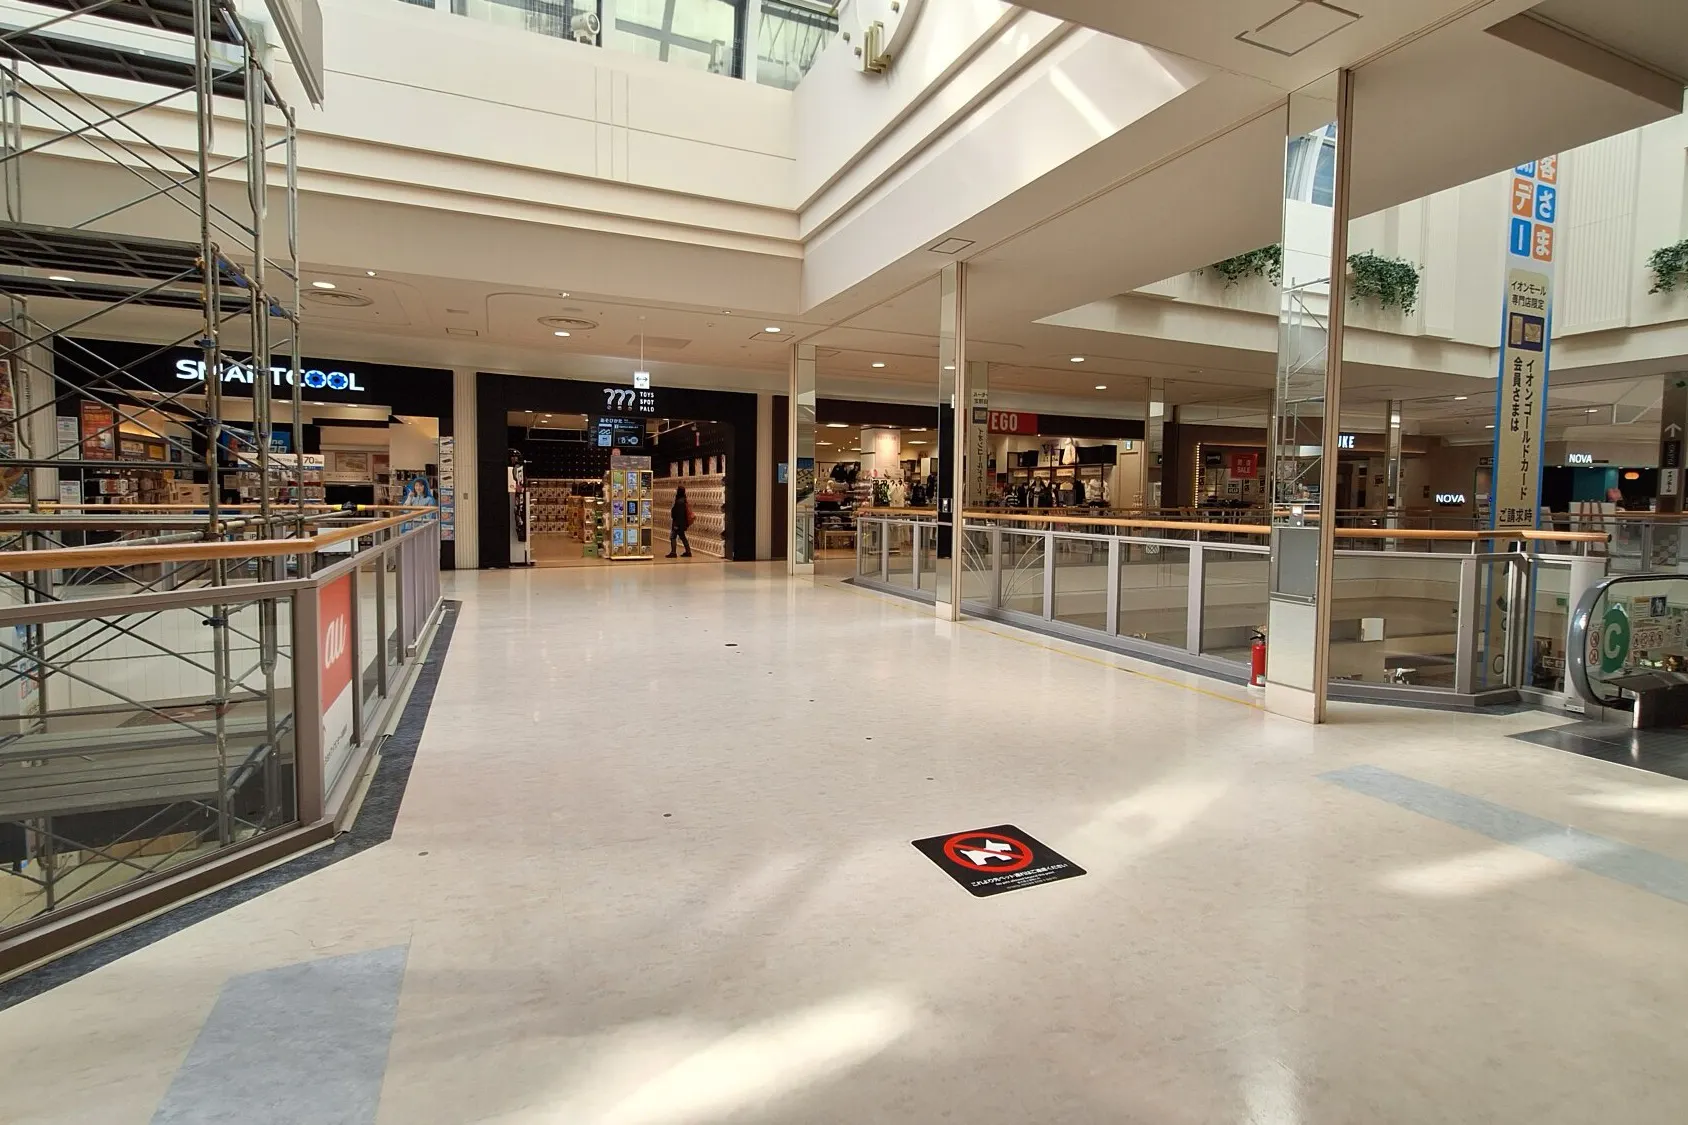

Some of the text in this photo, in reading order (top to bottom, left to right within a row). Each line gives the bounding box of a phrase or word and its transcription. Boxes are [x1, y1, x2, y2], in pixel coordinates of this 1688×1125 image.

[1511, 281, 1547, 296] イオンモール
[1512, 294, 1545, 310] 専門店限定
[1510, 356, 1523, 433] 会員さまは
[988, 411, 1018, 431] EGO
[1520, 359, 1535, 501] イオンゴールドカード
[1568, 453, 1592, 464] NOVA
[1436, 494, 1465, 503] NOVA
[1499, 508, 1533, 523] ご請求時
[325, 614, 346, 669] au
